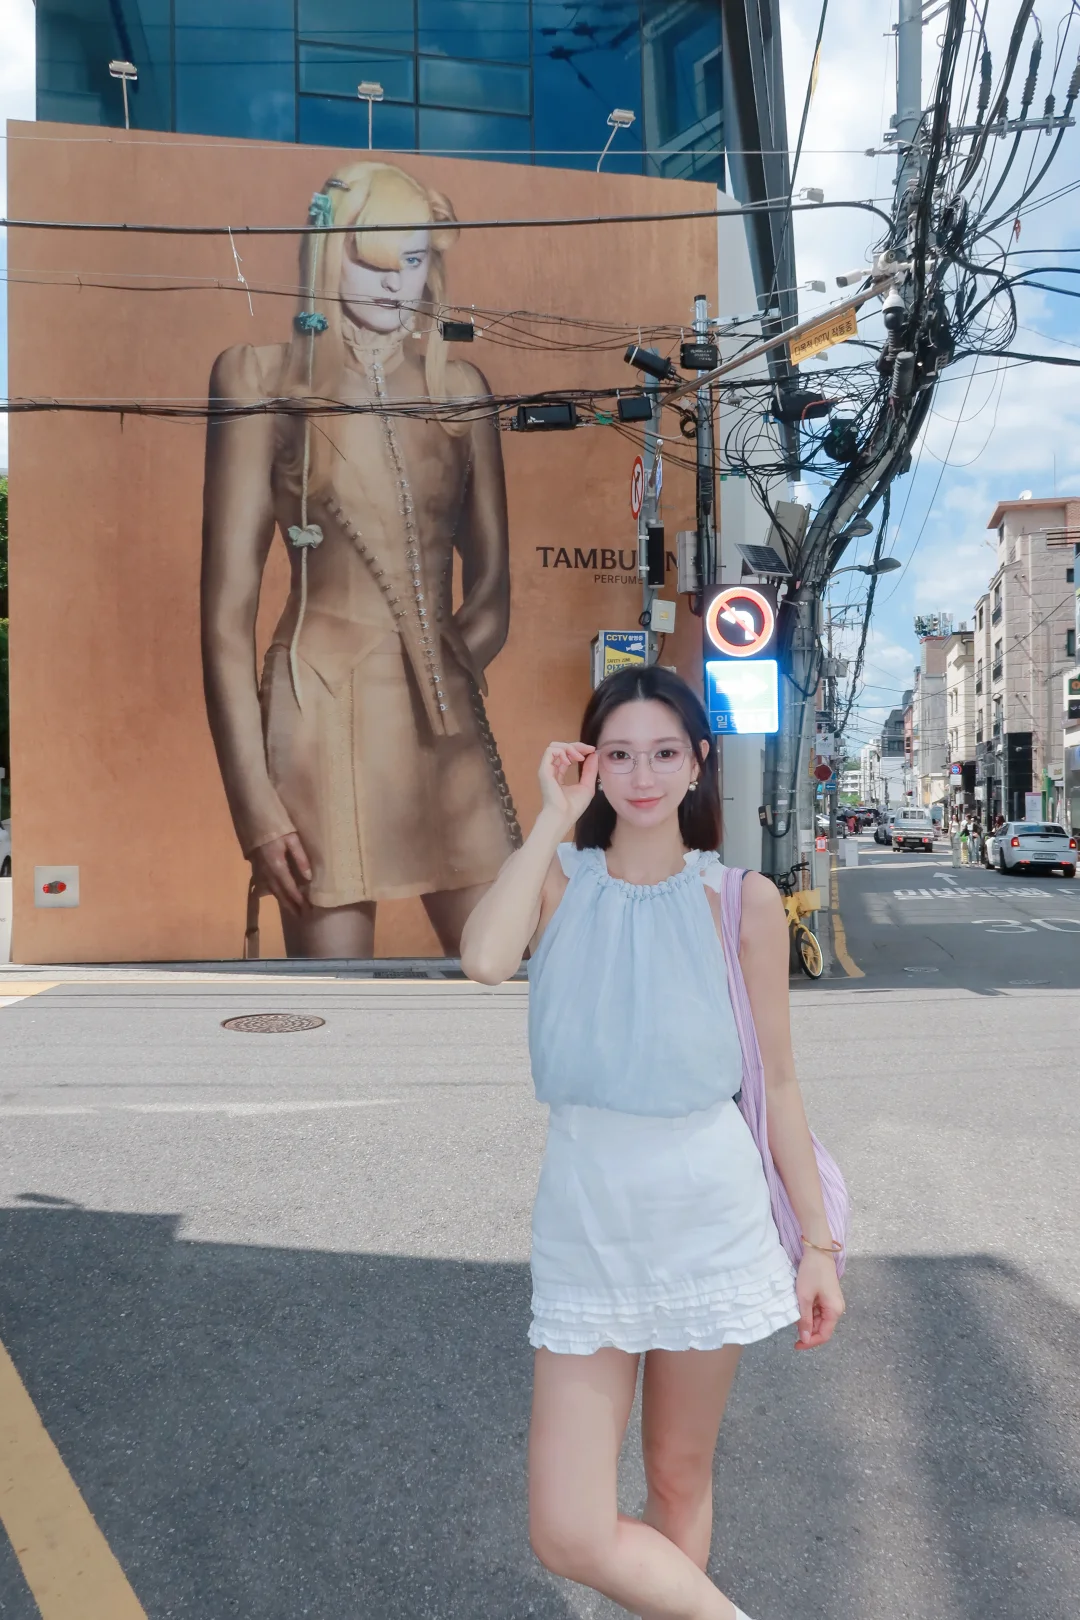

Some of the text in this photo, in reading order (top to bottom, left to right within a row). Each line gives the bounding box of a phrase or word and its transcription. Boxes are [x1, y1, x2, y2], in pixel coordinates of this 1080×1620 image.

[794, 320, 852, 356] 다목적 CCTV 작동중
[536, 546, 678, 571] TAMBUN
[971, 918, 1080, 934] 30
